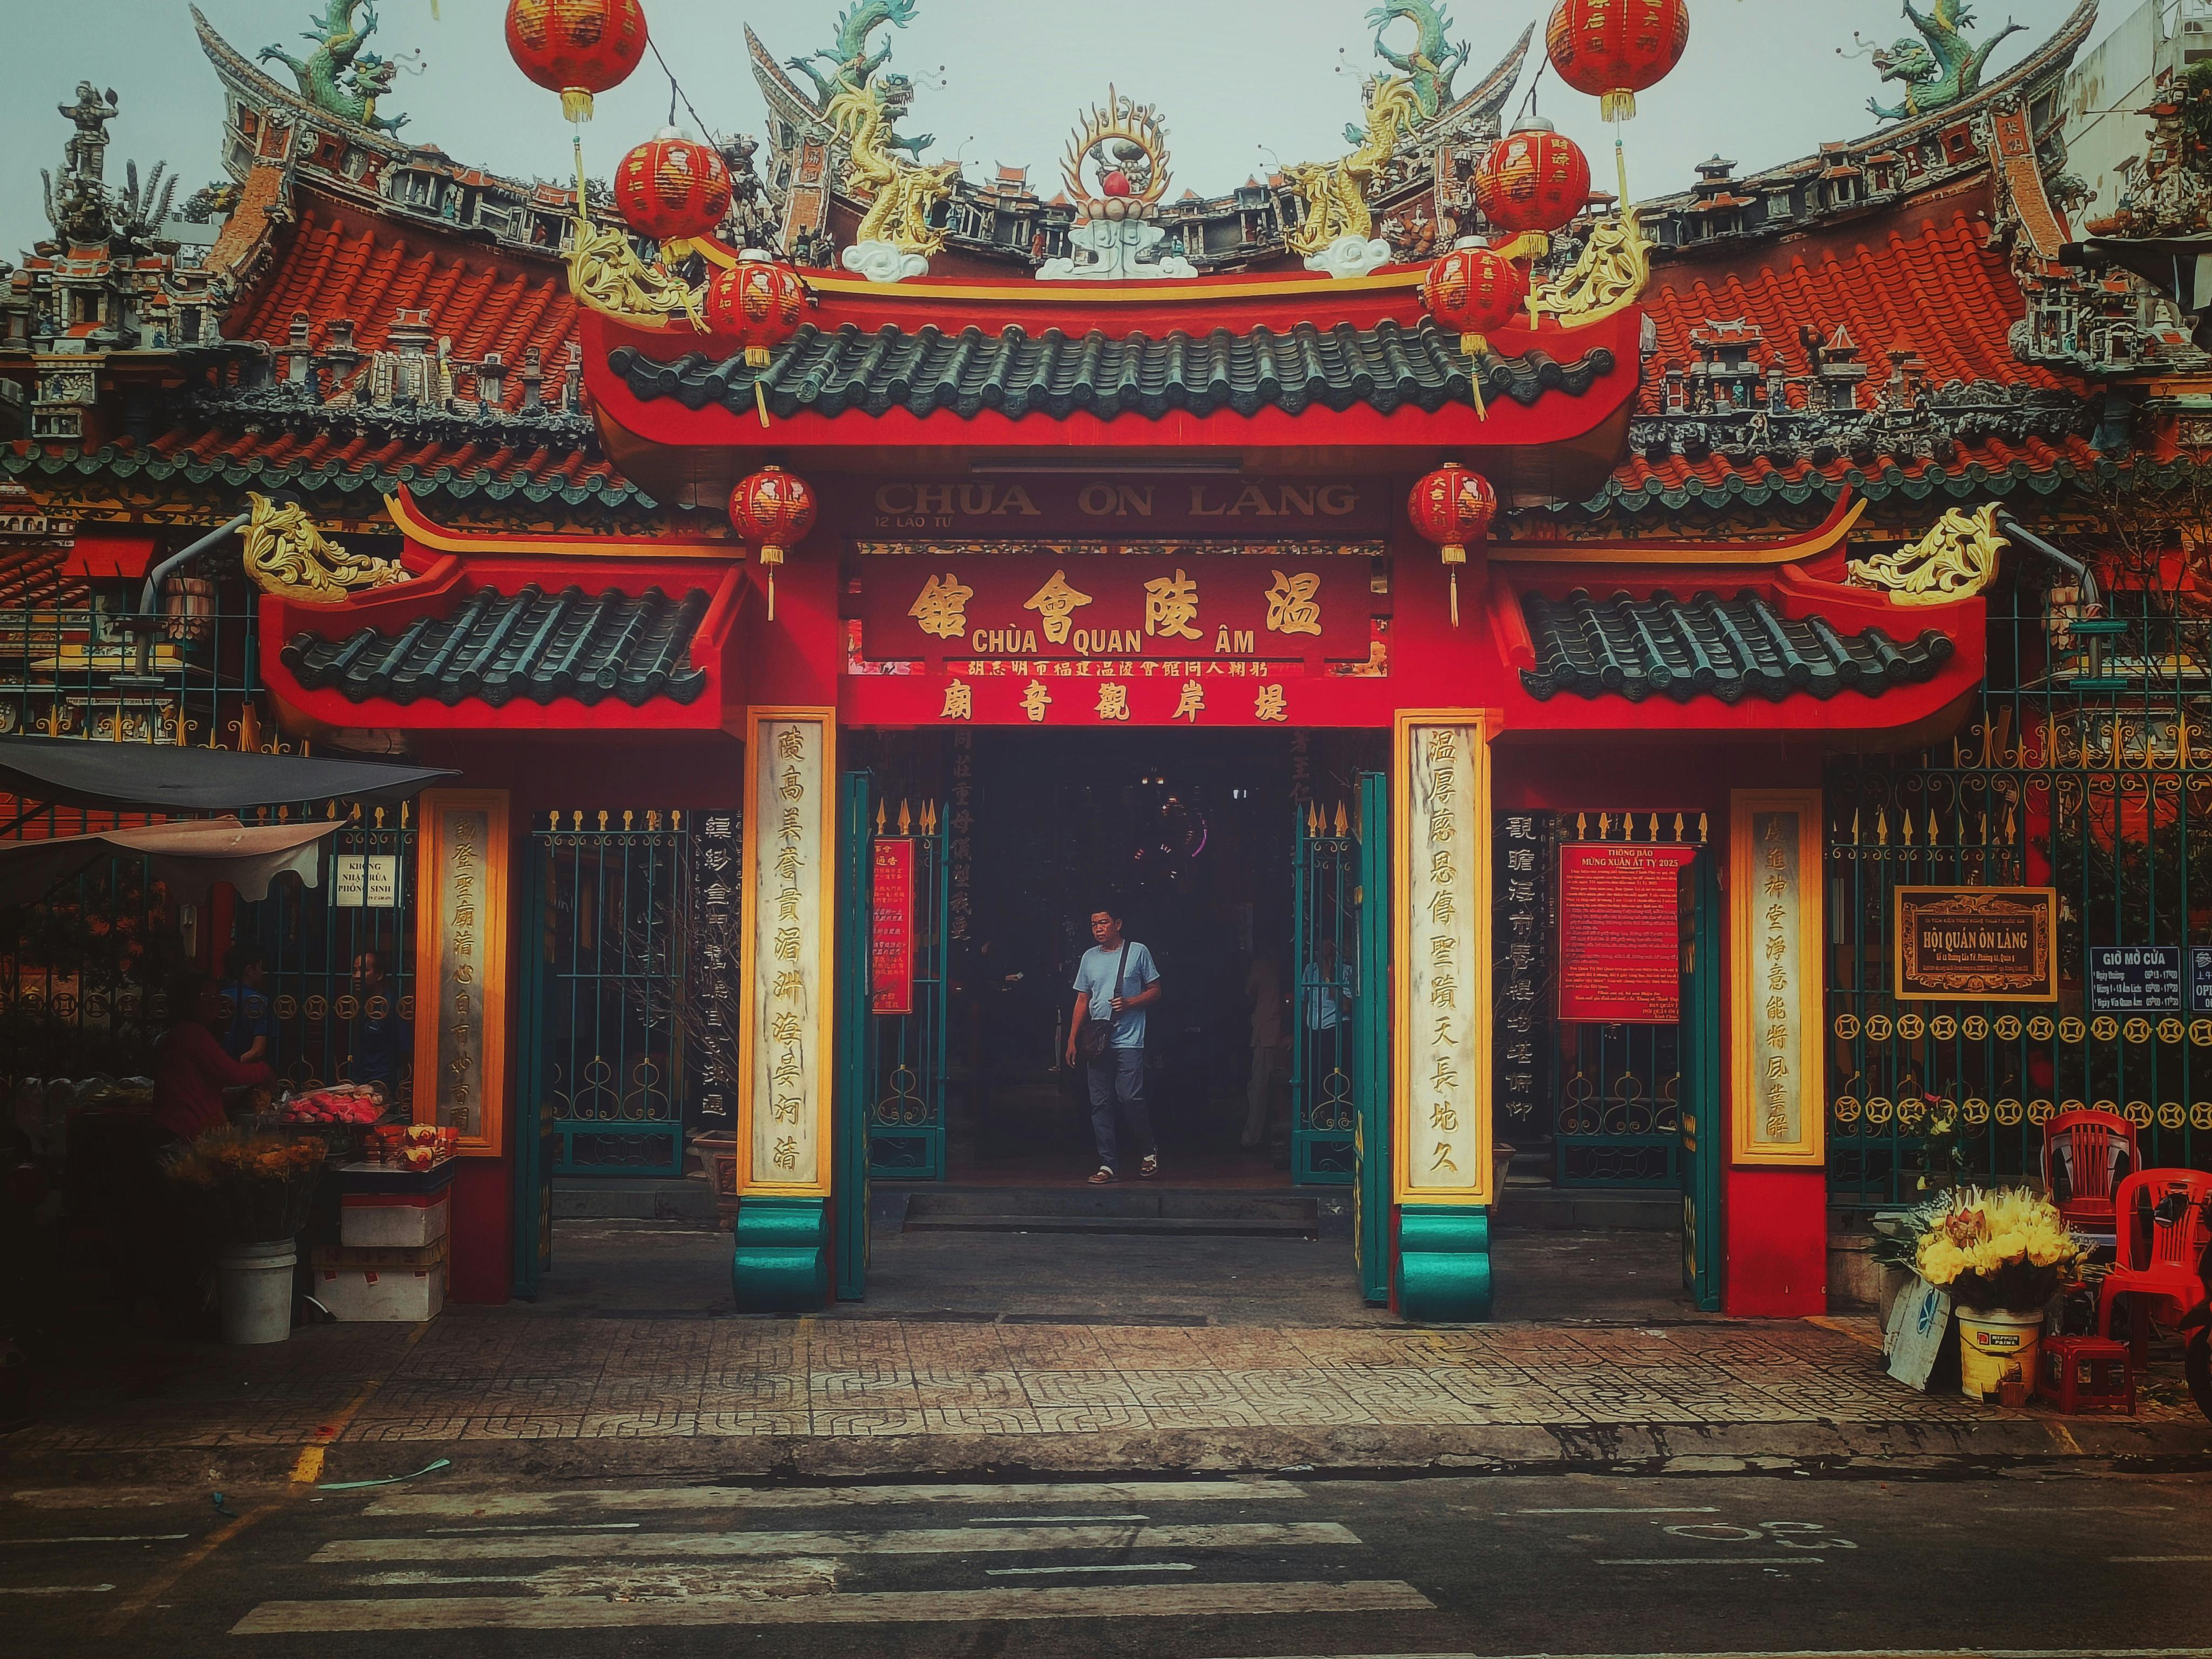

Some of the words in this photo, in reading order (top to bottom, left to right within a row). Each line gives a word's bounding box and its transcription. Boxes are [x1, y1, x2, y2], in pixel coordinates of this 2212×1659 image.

[874, 517, 891, 528] 12
[896, 515, 925, 528] LÃO
[972, 623, 1037, 653] CHÙA
[1073, 629, 1141, 657] QUAN
[1215, 624, 1254, 653] ÂM
[338, 882, 363, 892] PHÓN
[1923, 926, 1943, 952] HỘI
[1945, 926, 1976, 952] QUÁN
[1979, 926, 1994, 949] ÔN
[2103, 950, 2122, 965] GIỜ
[2125, 948, 2141, 965] MỞ
[2143, 948, 2166, 965] CỬA
